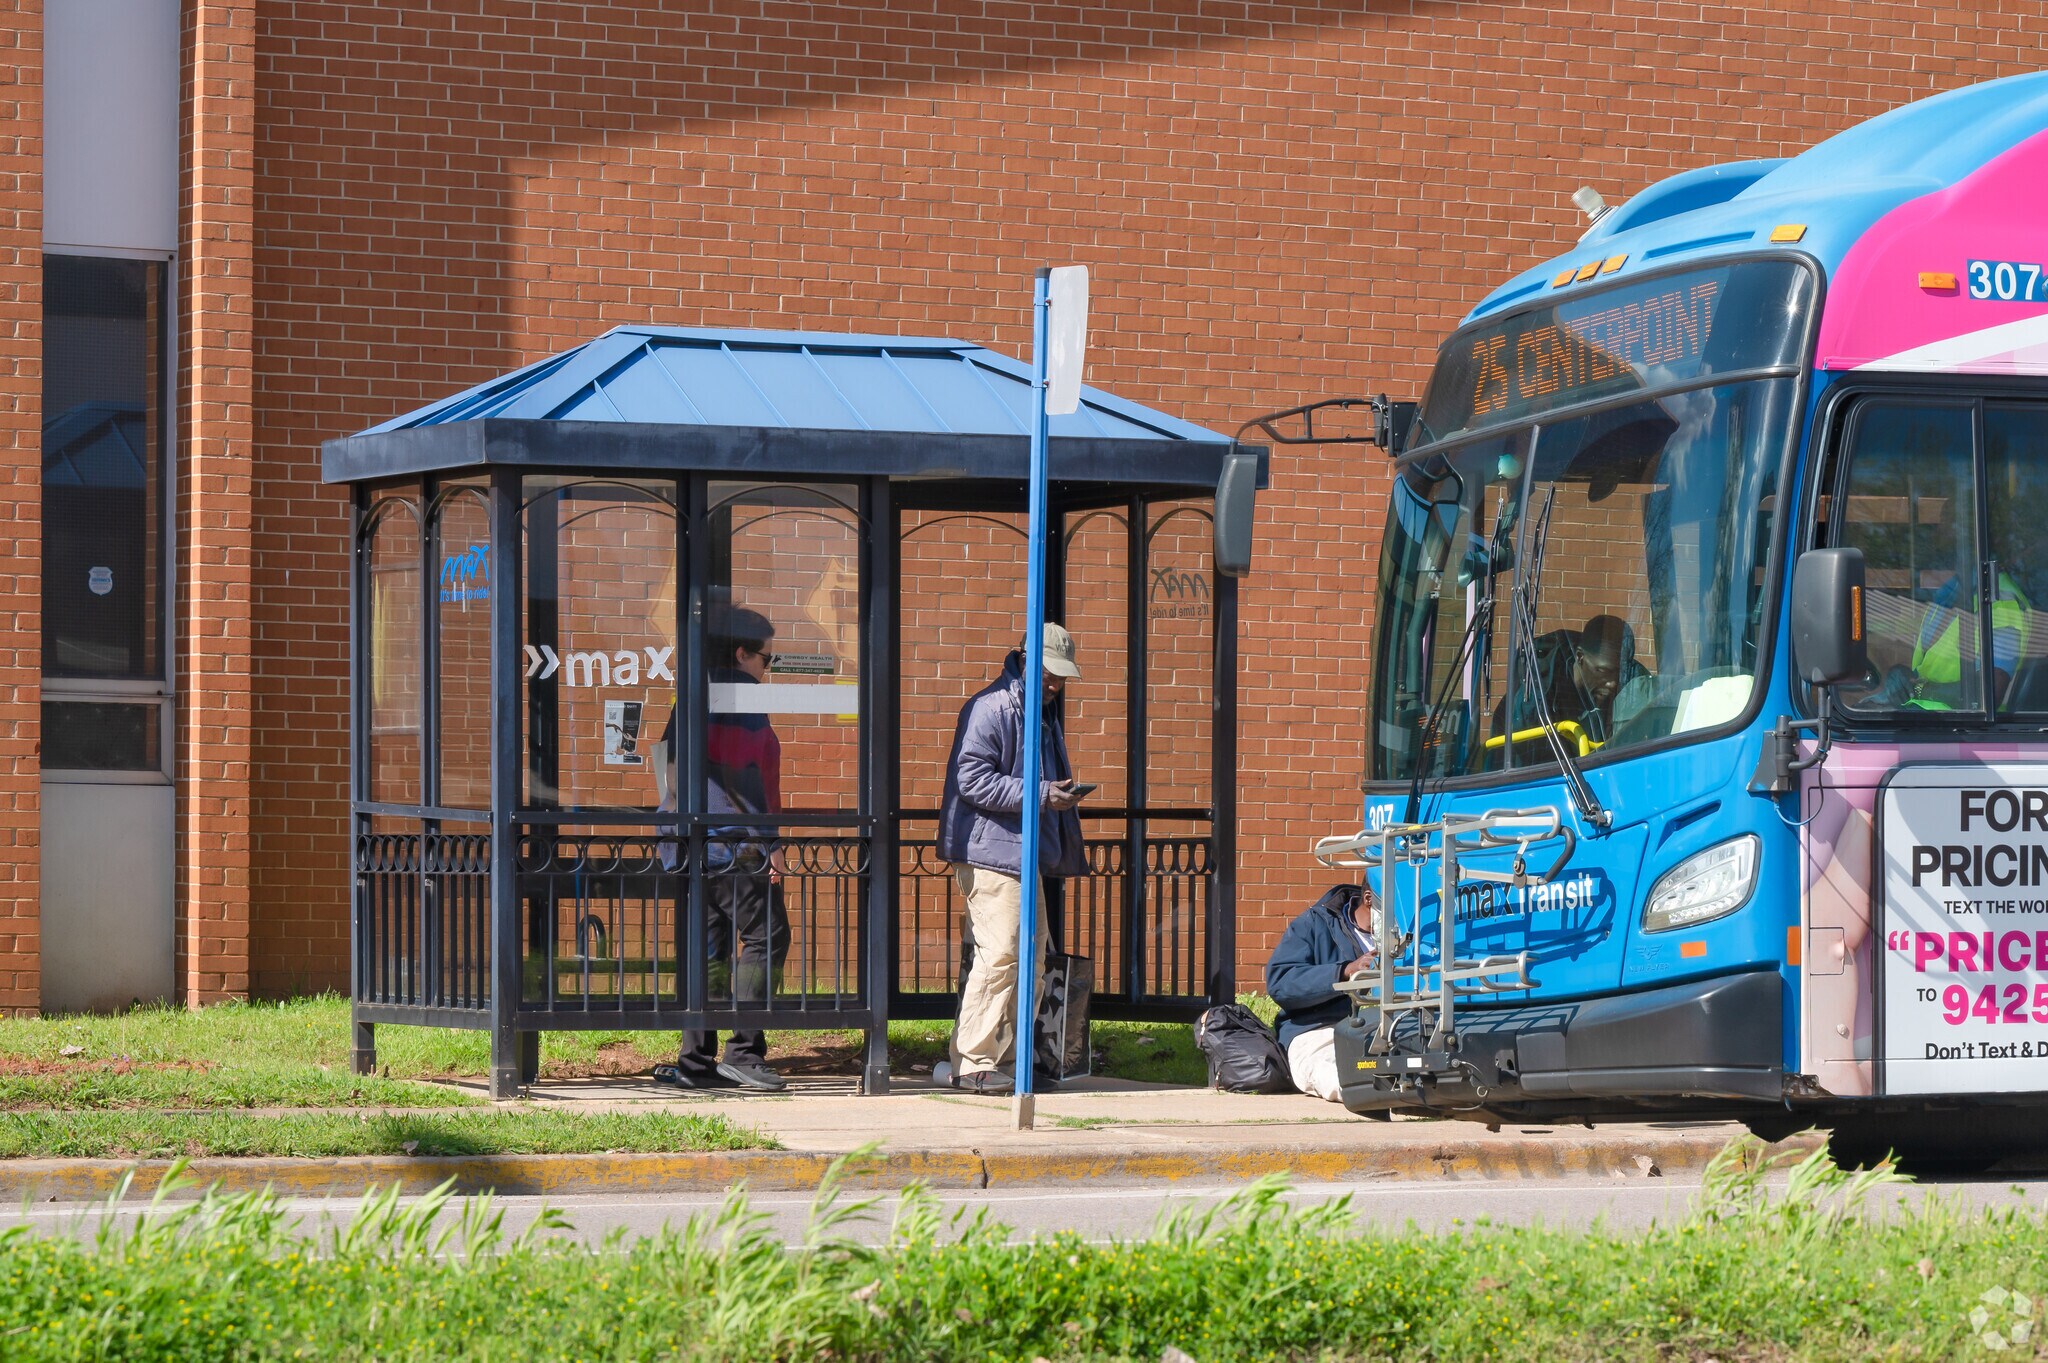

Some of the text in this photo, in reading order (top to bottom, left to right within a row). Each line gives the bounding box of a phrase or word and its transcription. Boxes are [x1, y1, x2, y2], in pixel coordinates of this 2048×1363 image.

[1969, 261, 2041, 300] 307
[1472, 281, 1717, 415] 25 CENTERPOINT
[565, 646, 675, 687] max
[1369, 803, 1394, 831] 307
[1960, 789, 2048, 832] FOR
[1944, 900, 2048, 914] TEXT THE WO
[1916, 988, 1937, 1002] TO
[1925, 1042, 1975, 1060] Don’t
[1979, 1041, 2017, 1059] Text
[2021, 1041, 2033, 1058] &
